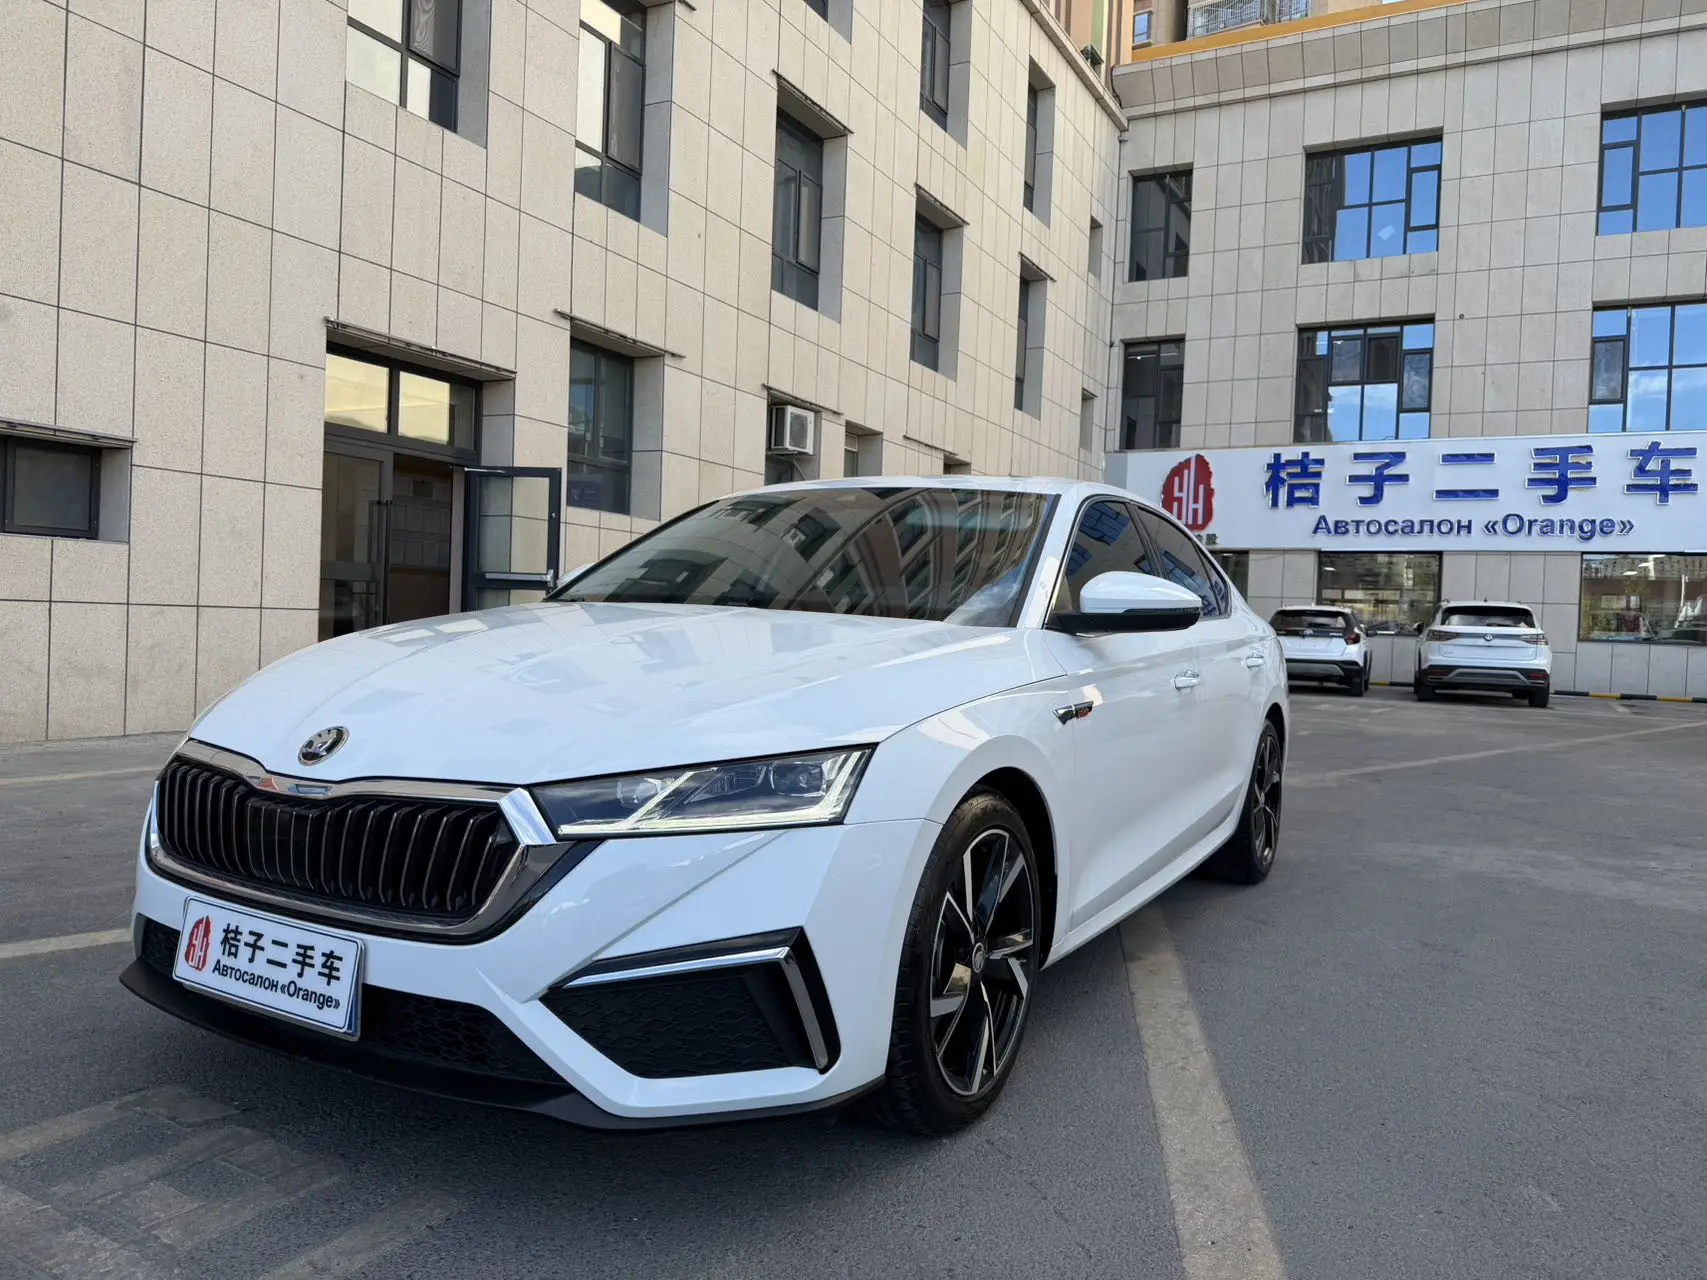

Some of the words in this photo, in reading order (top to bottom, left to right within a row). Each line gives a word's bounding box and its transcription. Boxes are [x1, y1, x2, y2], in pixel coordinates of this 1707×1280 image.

[1263, 440, 1699, 509] 桔子二手车
[1312, 514, 1473, 537] Автосалон
[1483, 513, 1635, 542] «Orange»
[220, 923, 343, 985] 桔子二手车
[212, 958, 279, 993] Автосалон
[280, 980, 341, 1010] «Orange»
